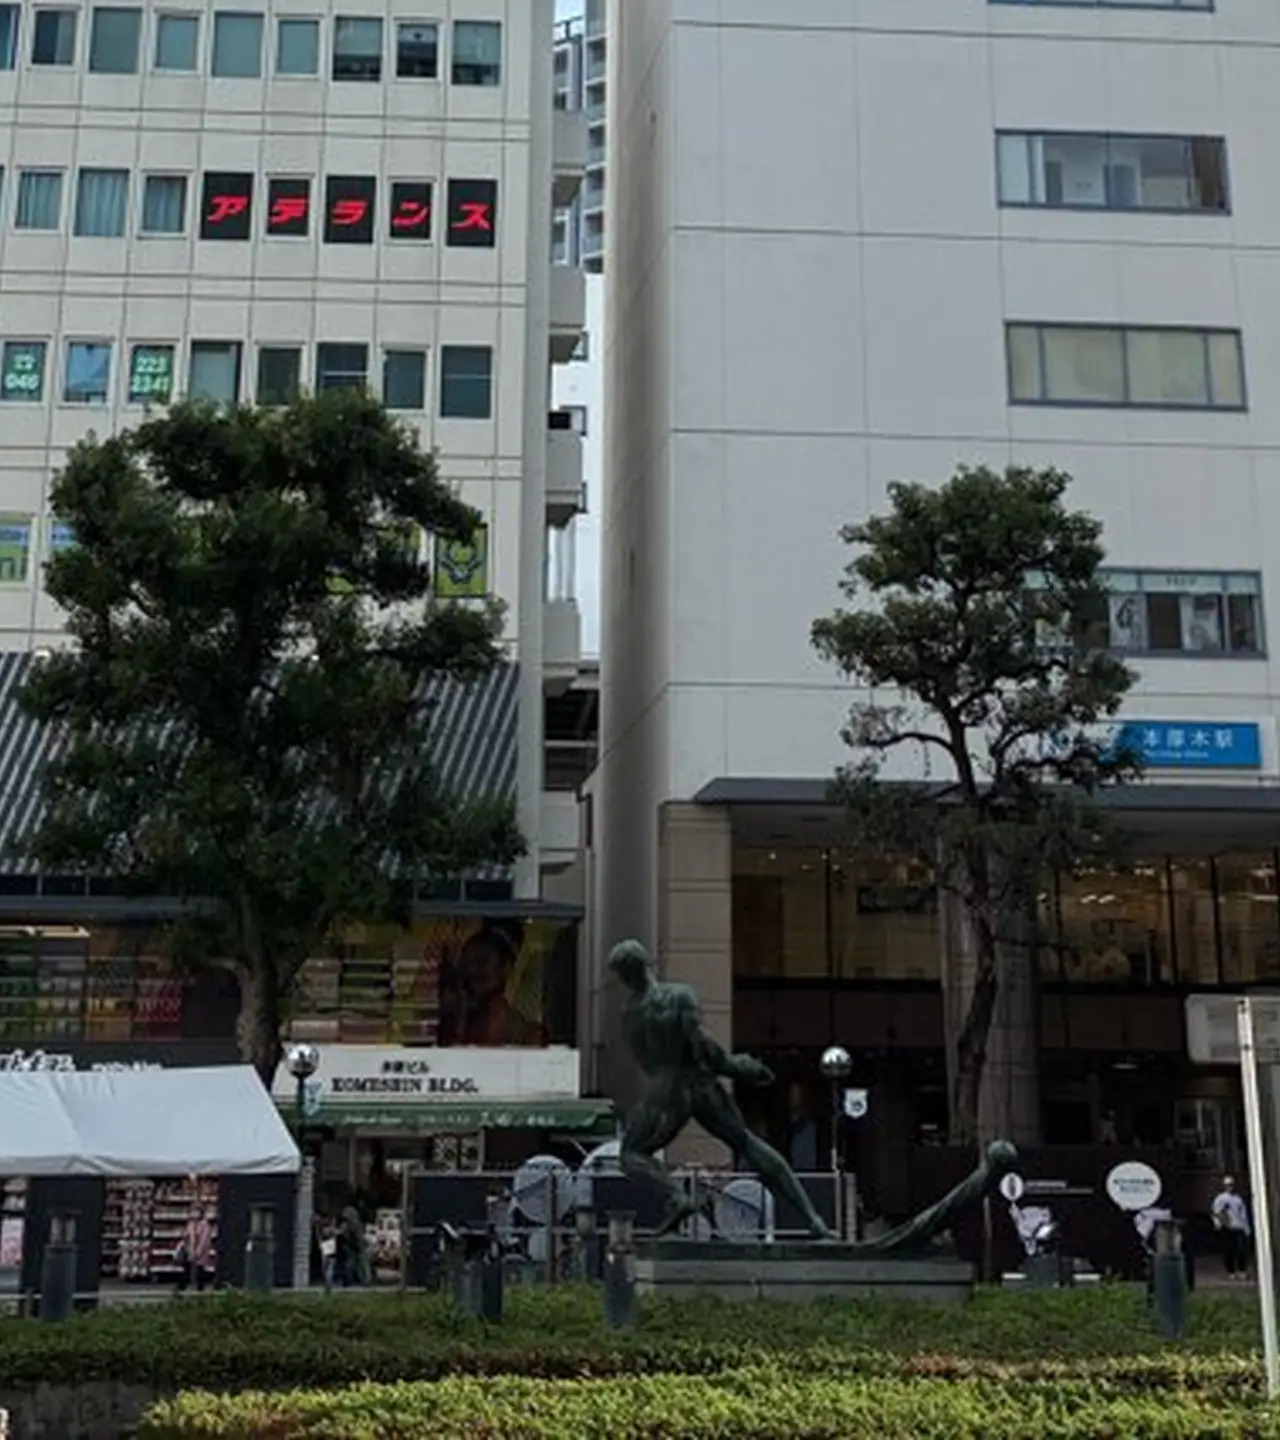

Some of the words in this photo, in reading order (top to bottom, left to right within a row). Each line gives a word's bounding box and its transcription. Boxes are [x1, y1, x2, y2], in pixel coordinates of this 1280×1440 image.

[207, 195, 491, 229] アデランス
